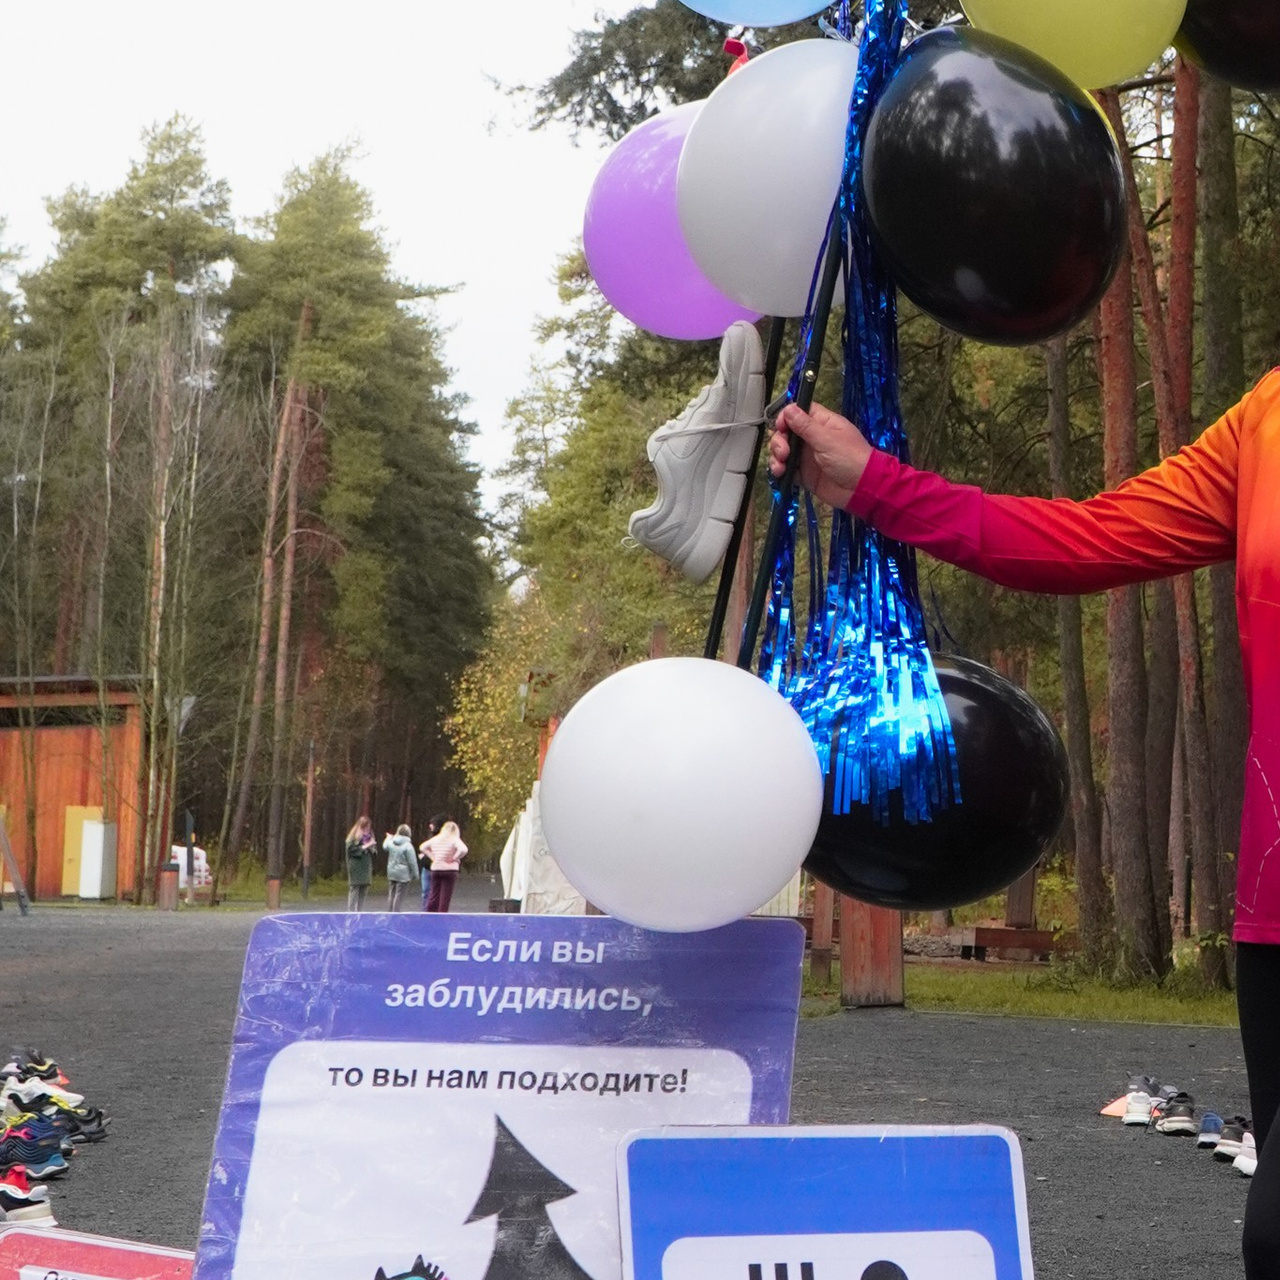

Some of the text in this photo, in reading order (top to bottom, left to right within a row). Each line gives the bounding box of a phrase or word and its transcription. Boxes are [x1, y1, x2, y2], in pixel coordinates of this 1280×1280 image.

[445, 931, 605, 964] Если вы
[384, 977, 653, 1016] заблудились,
[328, 1067, 688, 1096] то вы нам подходите!
